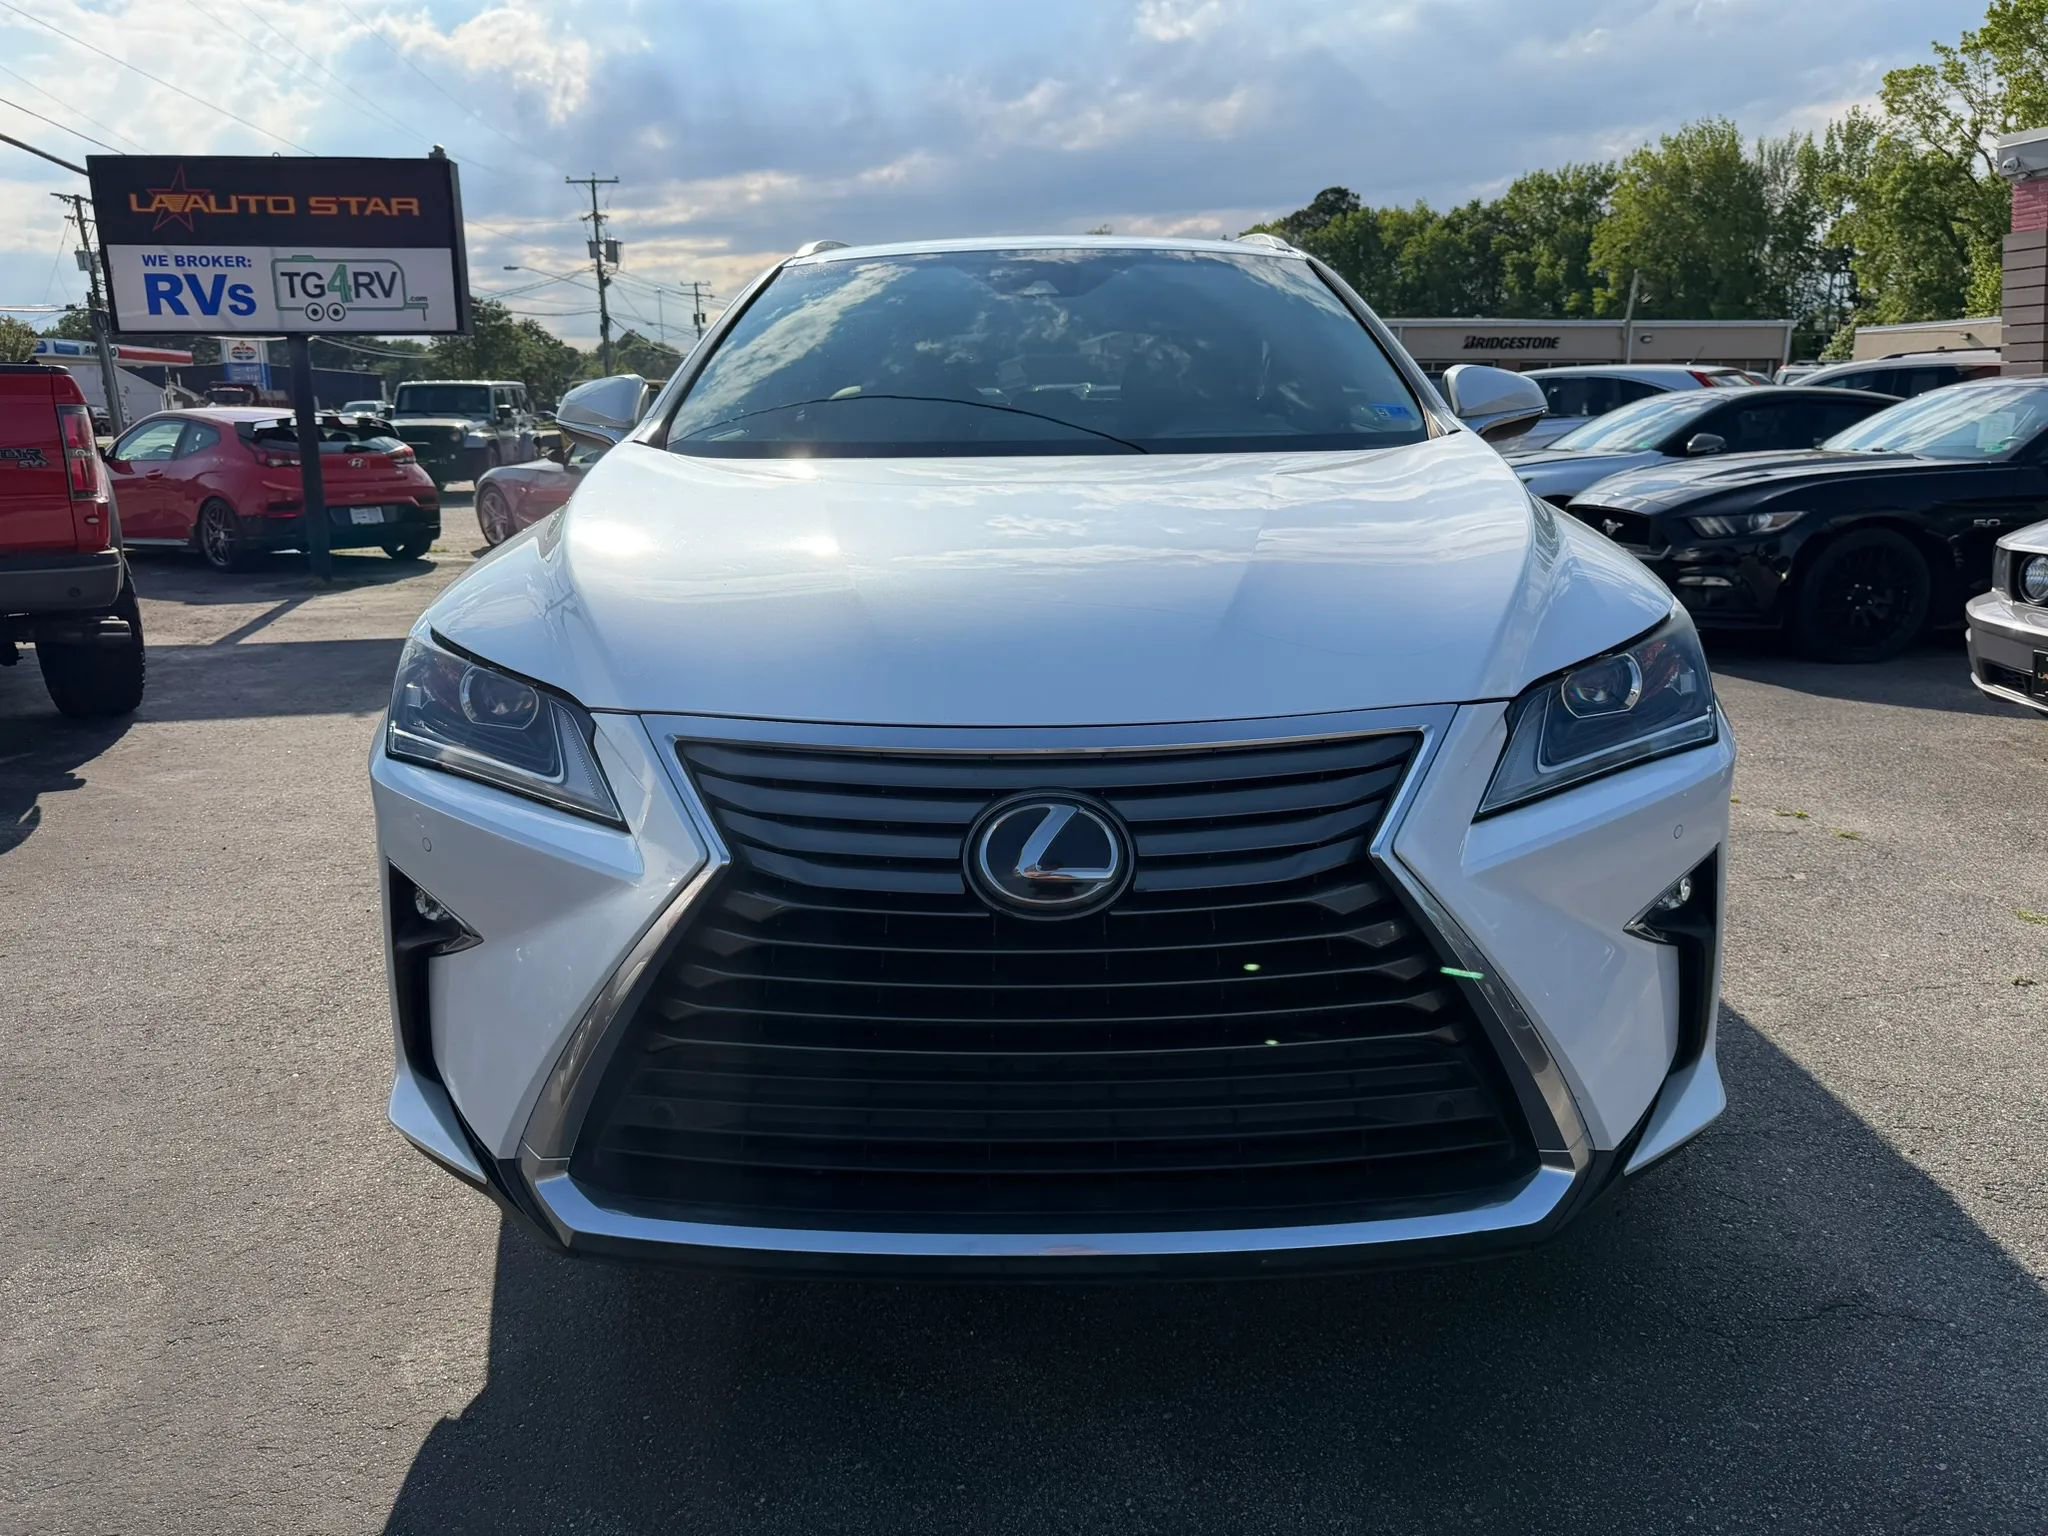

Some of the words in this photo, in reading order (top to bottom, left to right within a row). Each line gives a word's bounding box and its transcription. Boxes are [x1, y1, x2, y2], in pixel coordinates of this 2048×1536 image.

[183, 194, 297, 214] AUTO
[308, 196, 421, 216] STAR
[141, 254, 169, 267] WE
[174, 254, 252, 268] BROKER:
[143, 273, 257, 316] RVs
[280, 264, 397, 303] TG4RV
[1463, 335, 1560, 349] BRIDGESTONE
